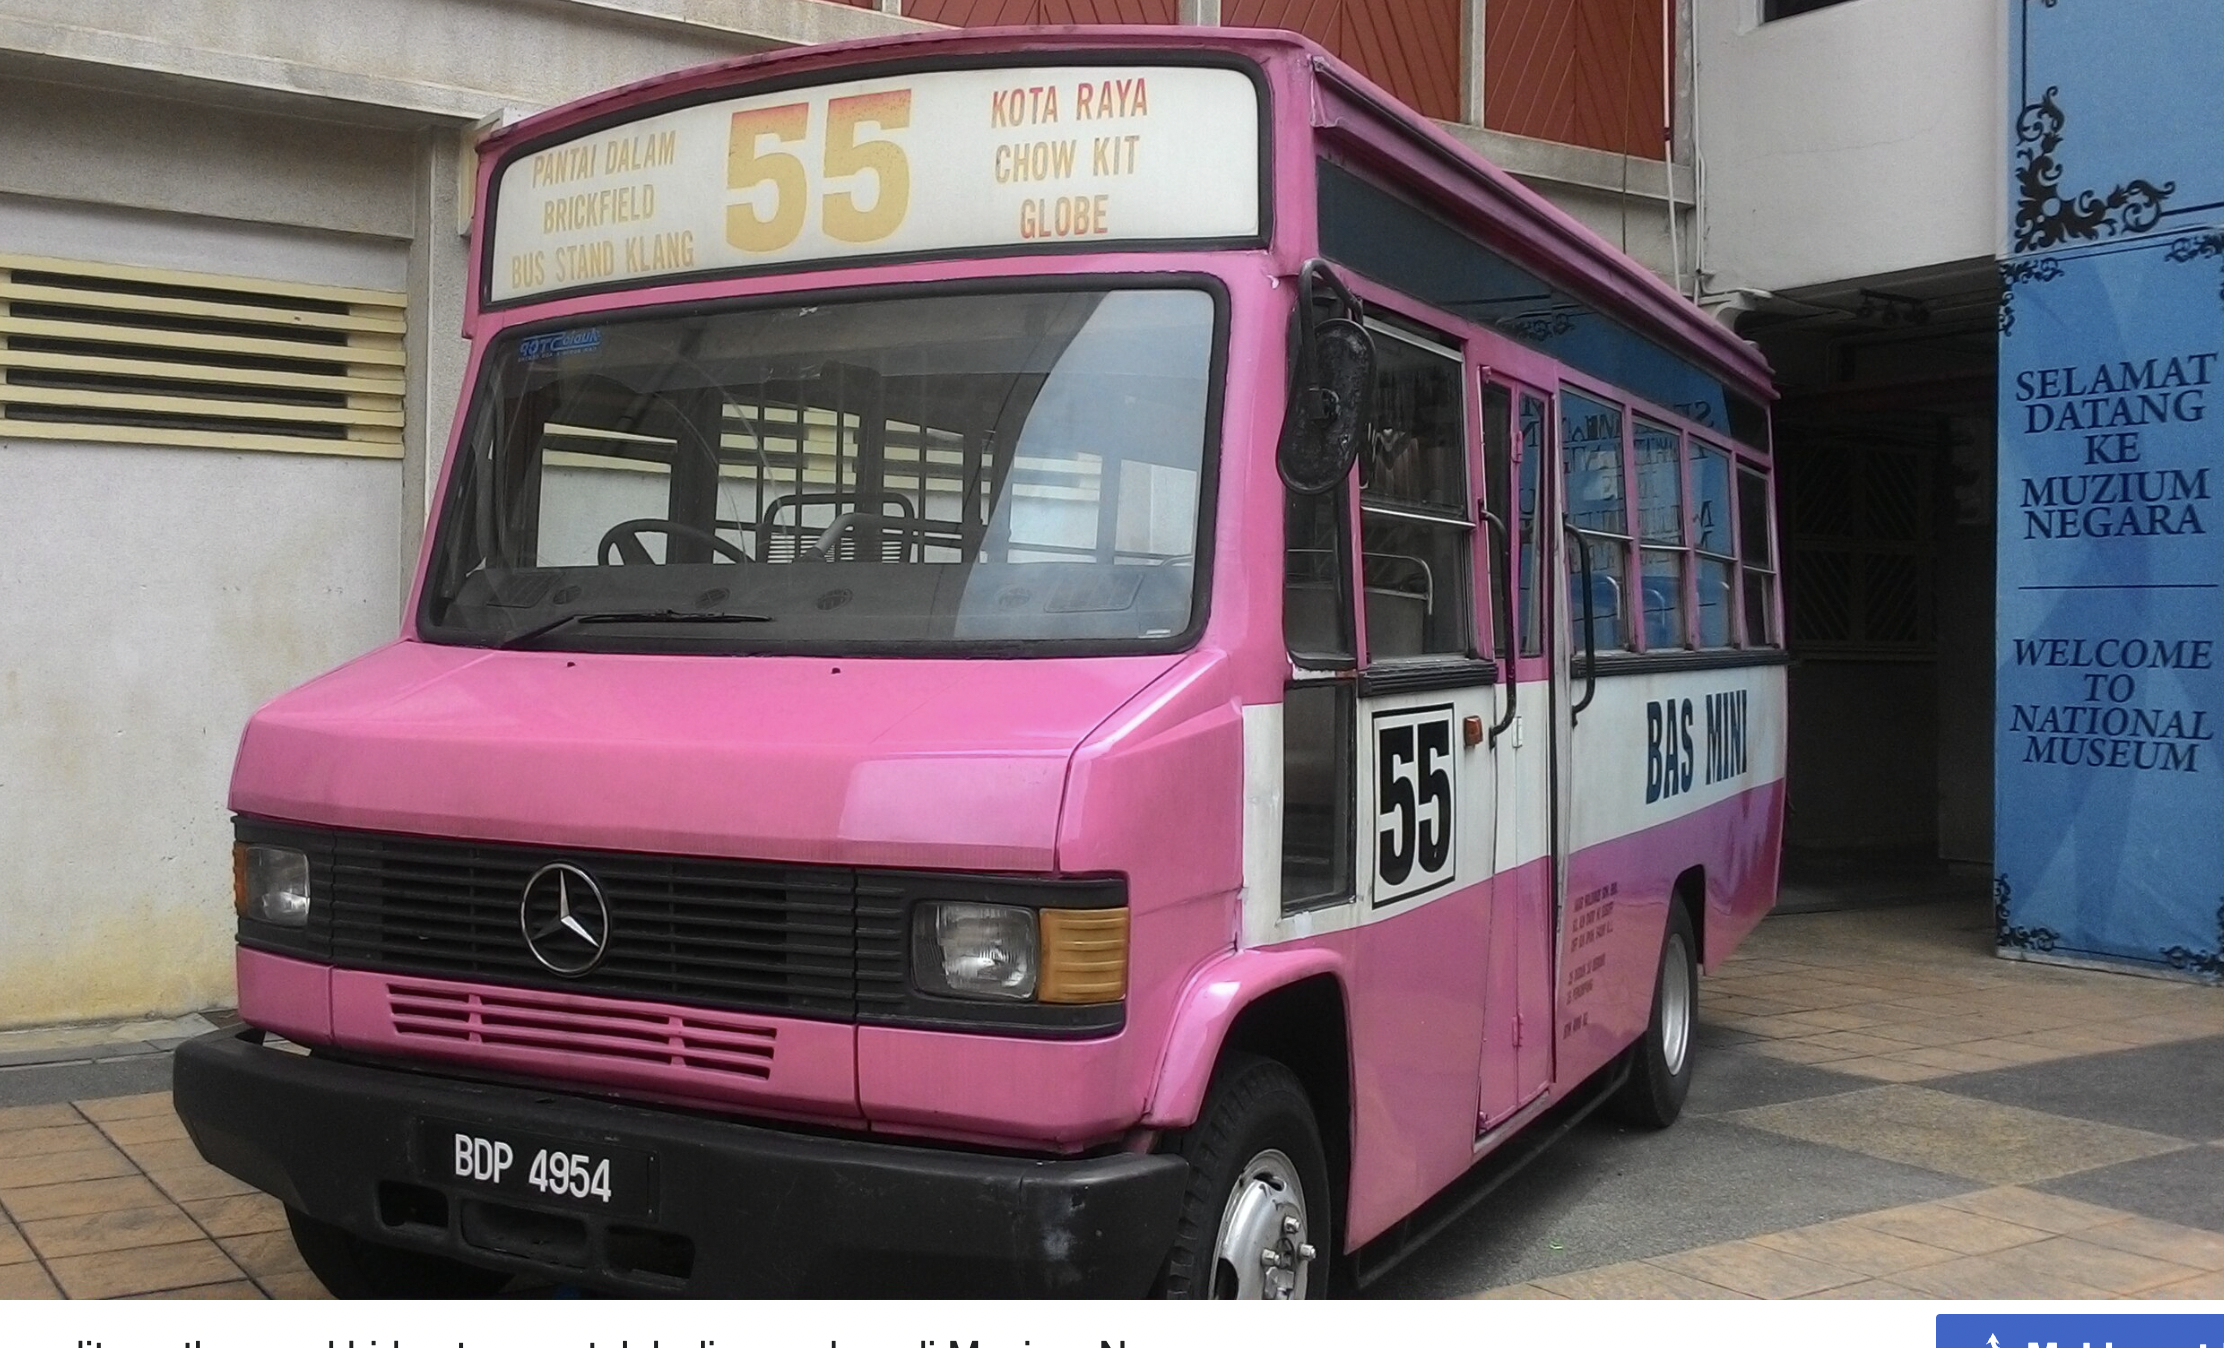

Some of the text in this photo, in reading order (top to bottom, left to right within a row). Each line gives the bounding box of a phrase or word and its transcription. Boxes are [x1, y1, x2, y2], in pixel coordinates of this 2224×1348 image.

[991, 77, 1148, 128] KOTA RAYA
[532, 130, 677, 189] PANTAI DALAM
[724, 88, 913, 253] 55
[995, 135, 1140, 183] CHOW KIT
[543, 183, 655, 234] BRICKFIELD
[1020, 194, 1109, 239] GLOBE
[511, 230, 694, 289] BUS STAND KLANG
[2015, 352, 2218, 402] SELAMAT
[2024, 390, 2206, 433] DATANG
[2084, 432, 2141, 465] KE
[2020, 468, 2211, 508] MUZIUM
[2024, 504, 2206, 540] NEGARA
[2013, 638, 2213, 669] WELCOME
[2084, 673, 2136, 703] TO
[2010, 704, 2214, 740] NATIONAL
[1645, 689, 1747, 805] BAS MINI
[2022, 735, 2200, 772] MUSEUM
[1379, 719, 1452, 886] 55
[455, 1133, 612, 1203] BDP 4954
